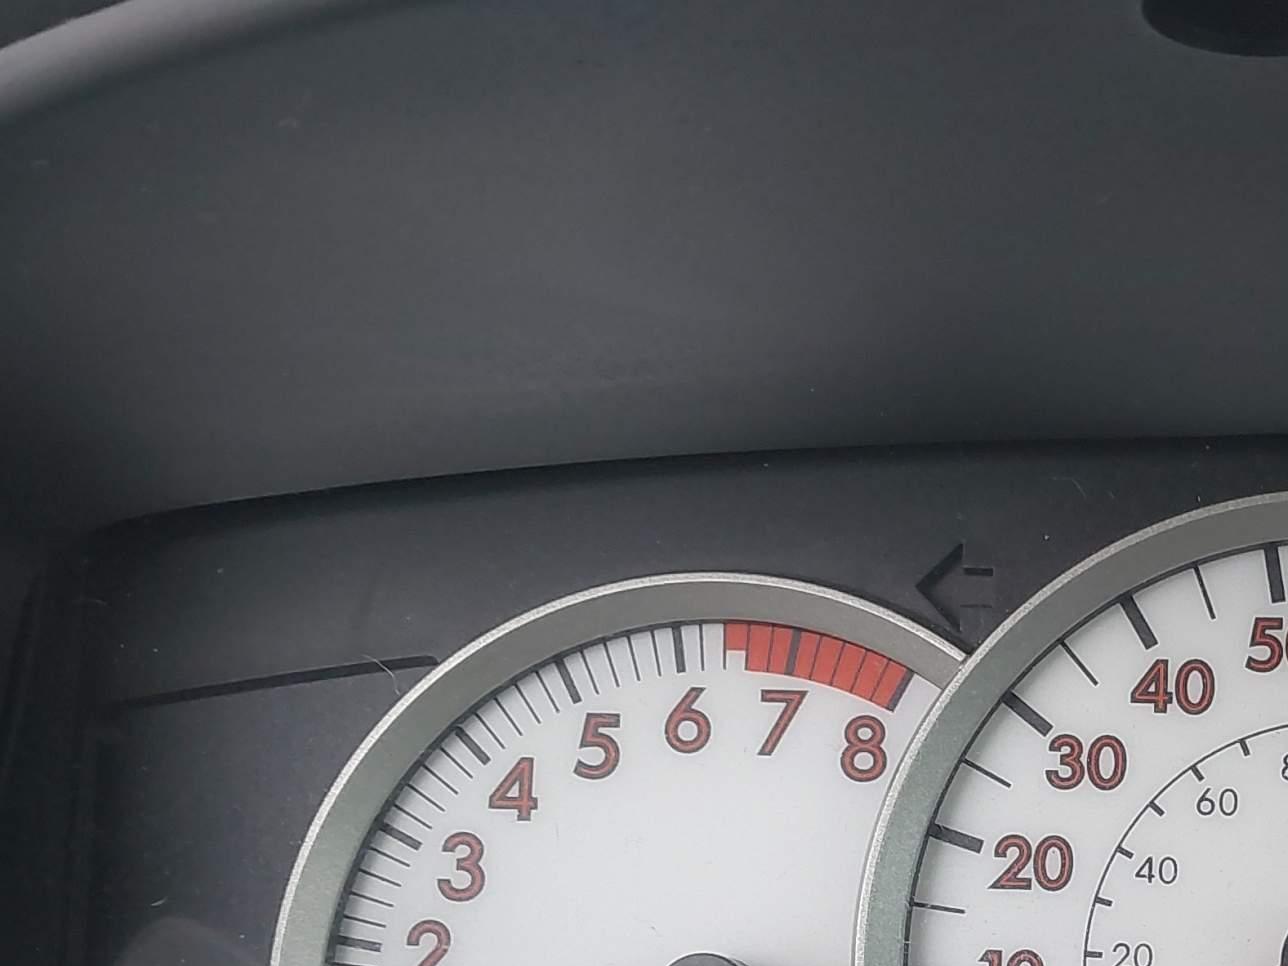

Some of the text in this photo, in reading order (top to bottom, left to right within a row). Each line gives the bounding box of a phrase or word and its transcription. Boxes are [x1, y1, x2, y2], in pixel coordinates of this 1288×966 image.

[1130, 659, 1215, 715] 40
[573, 712, 620, 780] 5
[664, 687, 711, 754] 6
[757, 689, 809, 756] 7
[840, 715, 887, 782] 8
[488, 758, 538, 821] 4
[1045, 734, 1127, 791] 30
[1196, 788, 1238, 816] 60
[437, 832, 485, 902] 3
[987, 834, 1073, 892] 20
[1135, 856, 1177, 884] 40
